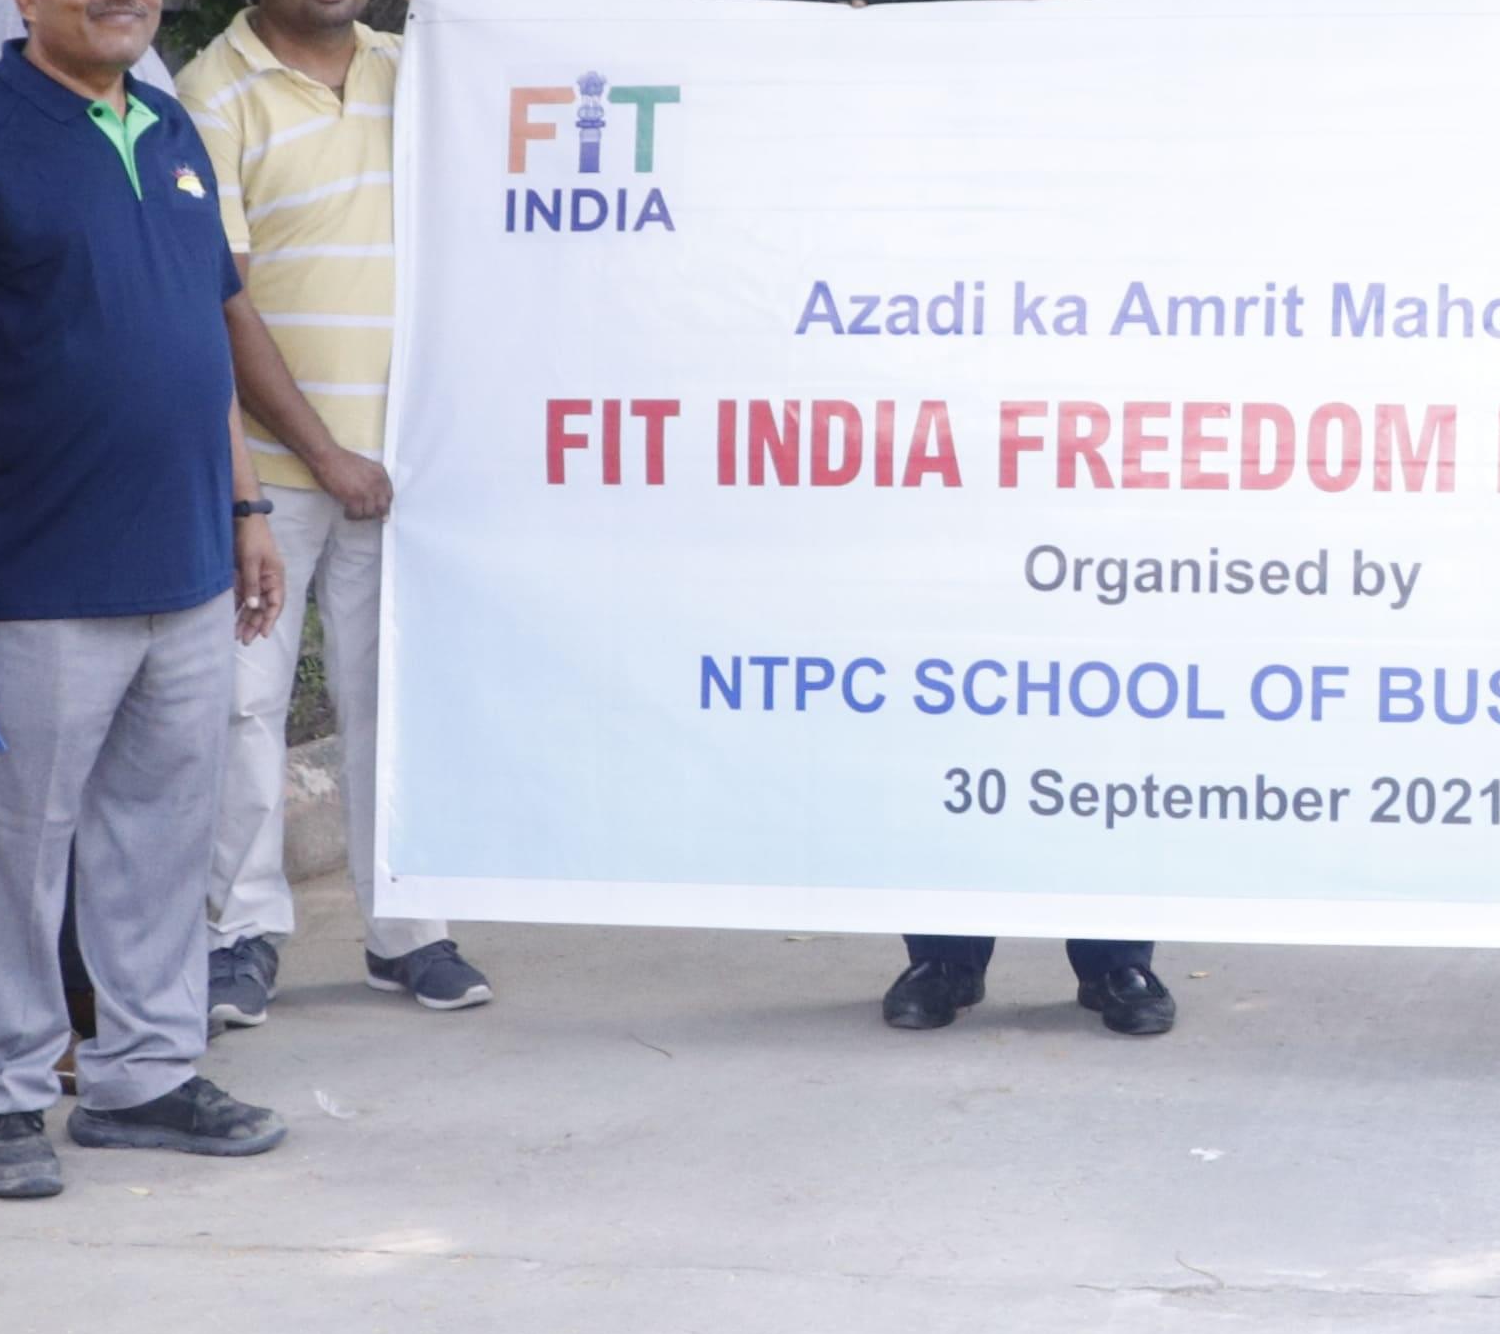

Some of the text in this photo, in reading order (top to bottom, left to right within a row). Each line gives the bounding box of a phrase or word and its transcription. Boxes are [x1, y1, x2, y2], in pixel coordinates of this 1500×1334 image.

[505, 187, 676, 232] INDIA
[793, 279, 985, 337] Azadi
[1012, 280, 1088, 337] ka
[1108, 281, 1305, 338] Amrit
[545, 398, 682, 487] FIT
[716, 398, 965, 489] INDIA
[997, 400, 1459, 495] FREEDOM
[1024, 544, 1423, 611] Organised by
[699, 654, 887, 715] NTPC
[912, 657, 1227, 721] SCHOOL
[1249, 663, 1350, 723] OF
[942, 766, 1007, 816] 30
[1027, 768, 1352, 830] September
